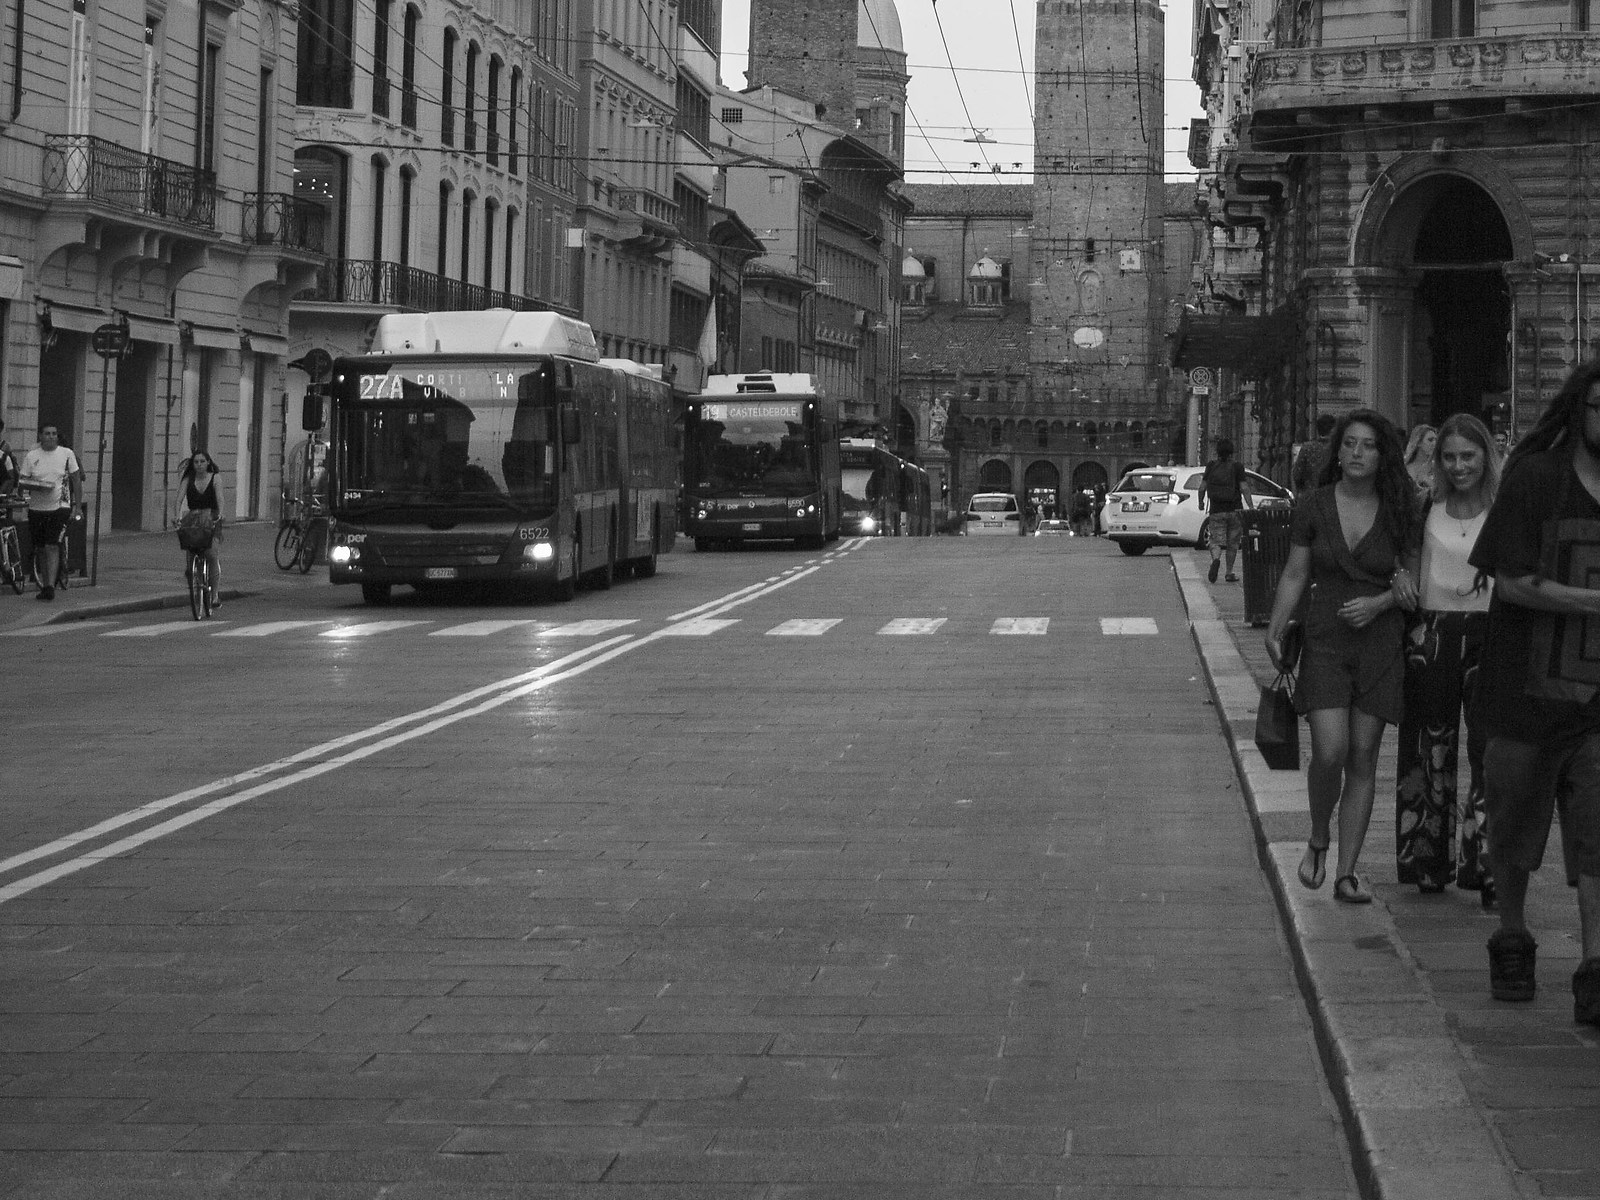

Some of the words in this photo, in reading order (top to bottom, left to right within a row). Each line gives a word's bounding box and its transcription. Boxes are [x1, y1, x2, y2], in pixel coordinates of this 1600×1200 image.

[417, 373, 514, 386] CORTILA
[360, 374, 404, 399] 27A
[423, 386, 448, 399] VIA
[729, 406, 798, 418] CASTELDEBOLE
[520, 527, 550, 540] 6522
